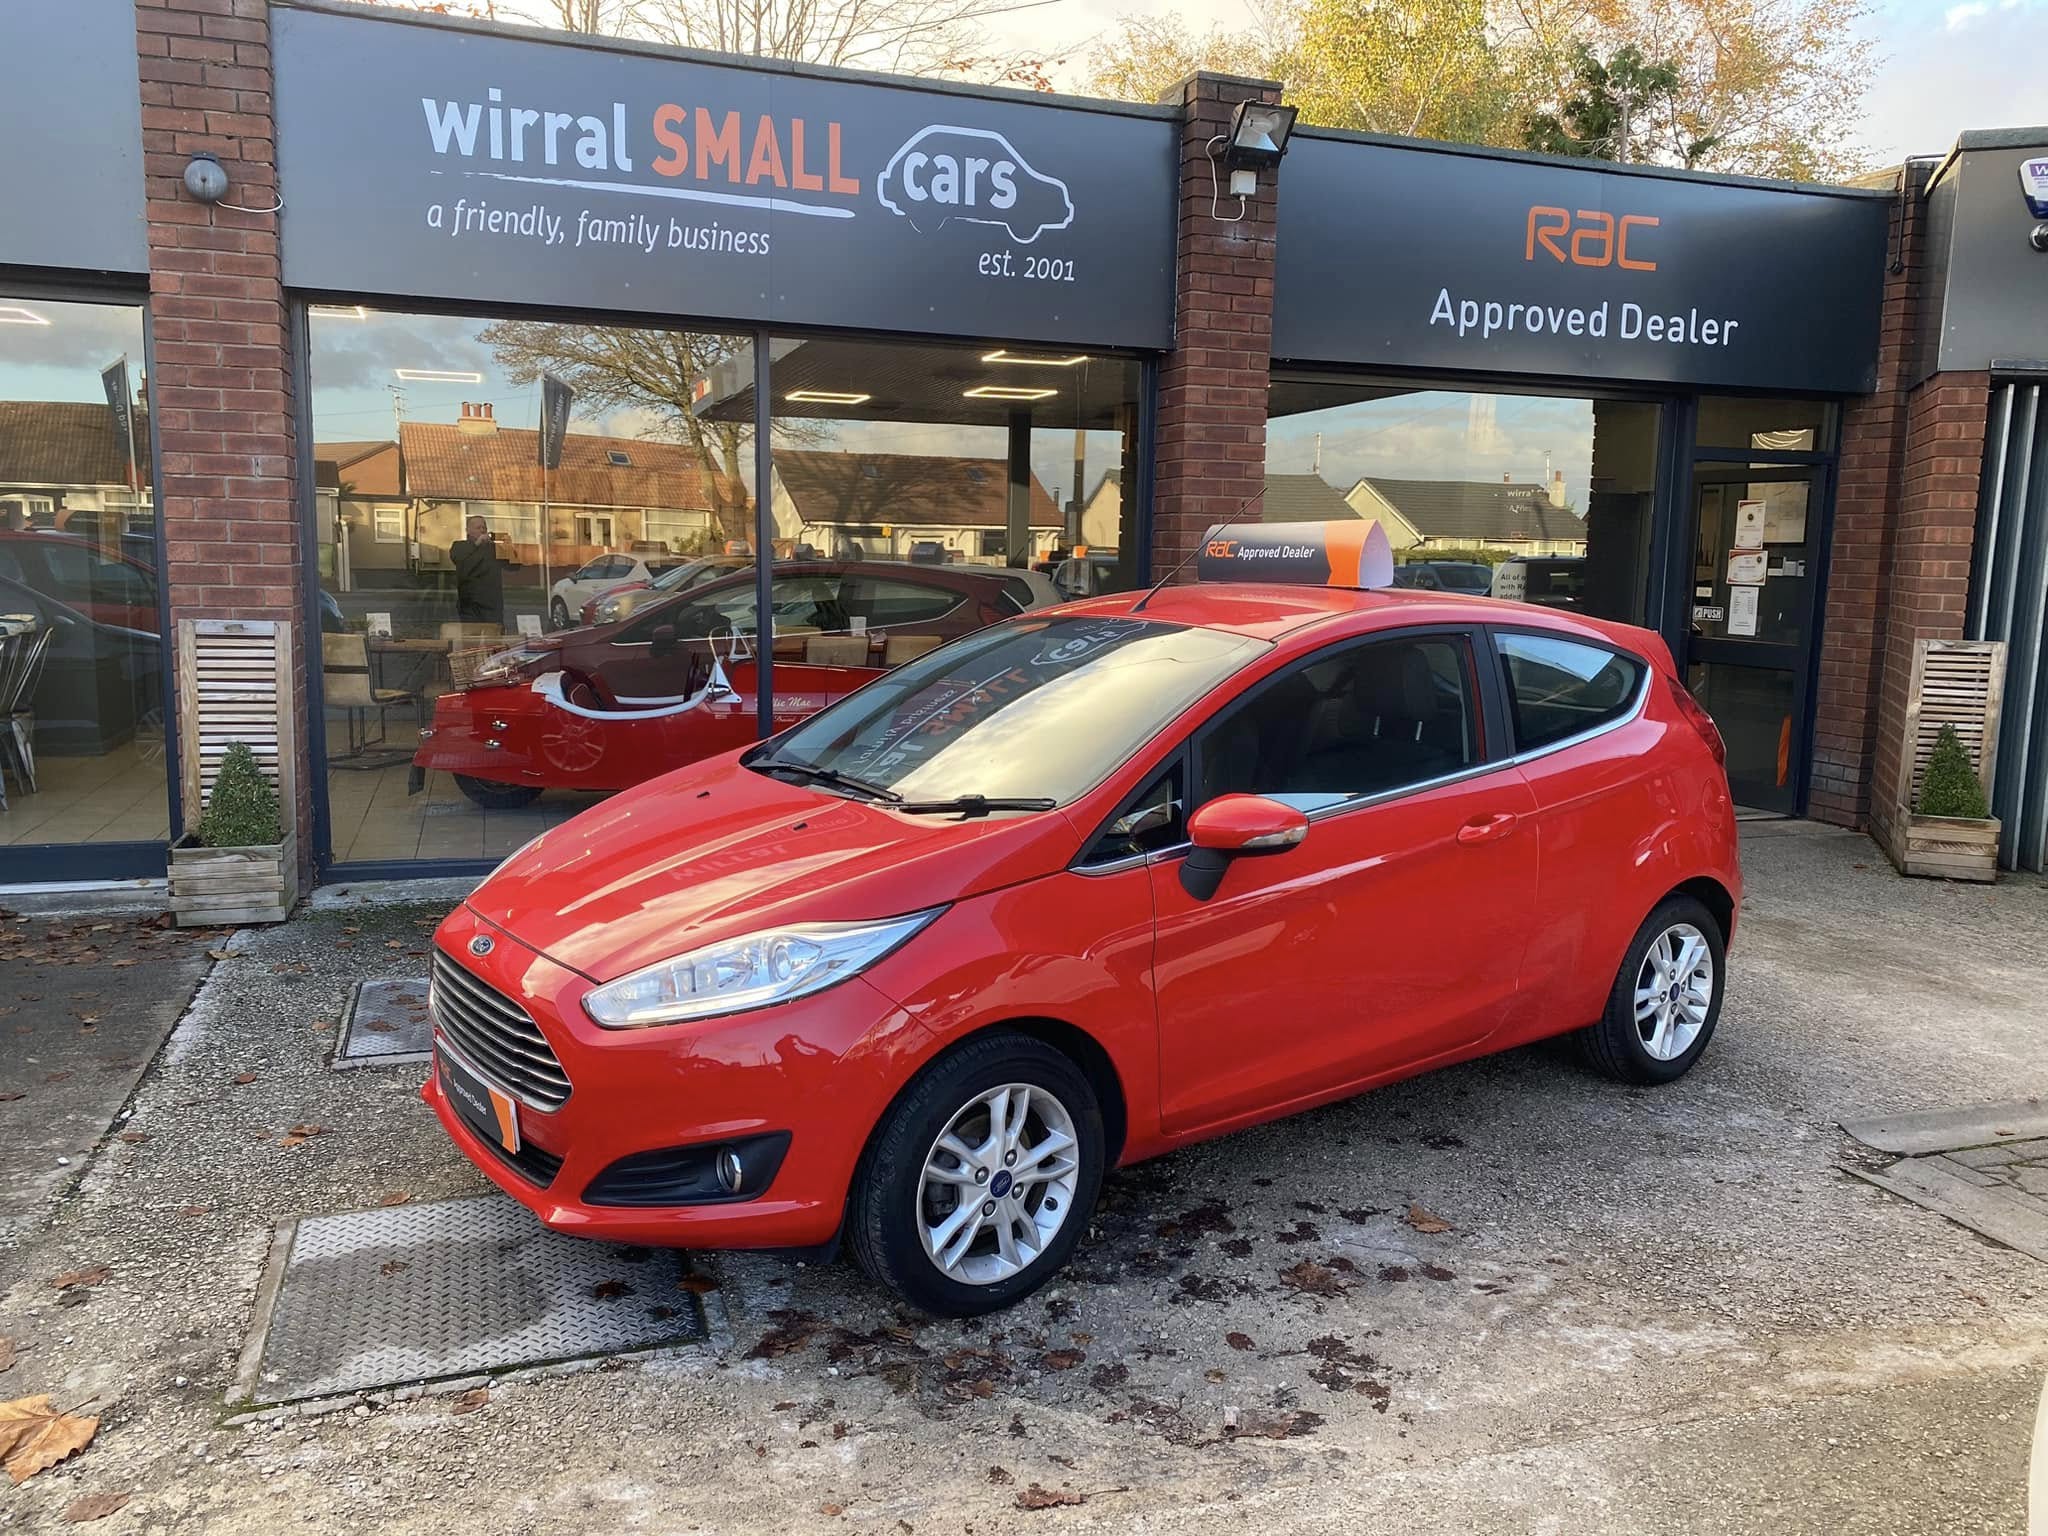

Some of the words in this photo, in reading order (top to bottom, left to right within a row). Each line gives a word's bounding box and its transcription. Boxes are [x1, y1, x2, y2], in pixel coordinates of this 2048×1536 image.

[421, 87, 633, 173] wirral
[651, 103, 860, 195] SMALL
[902, 151, 1018, 210] cars
[426, 203, 443, 228] a
[451, 199, 566, 245] friendly,
[574, 209, 660, 253] family
[667, 217, 771, 255] business
[1525, 205, 1660, 272] RAC
[978, 249, 1016, 278] est.
[1024, 256, 1076, 282] 2001
[1430, 288, 1609, 339] Approved
[1620, 302, 1739, 346] Dealer
[1205, 540, 1238, 558] RAC
[1237, 545, 1281, 560] Approved
[1282, 545, 1316, 558] Dealer
[1703, 608, 1722, 619] PUSH
